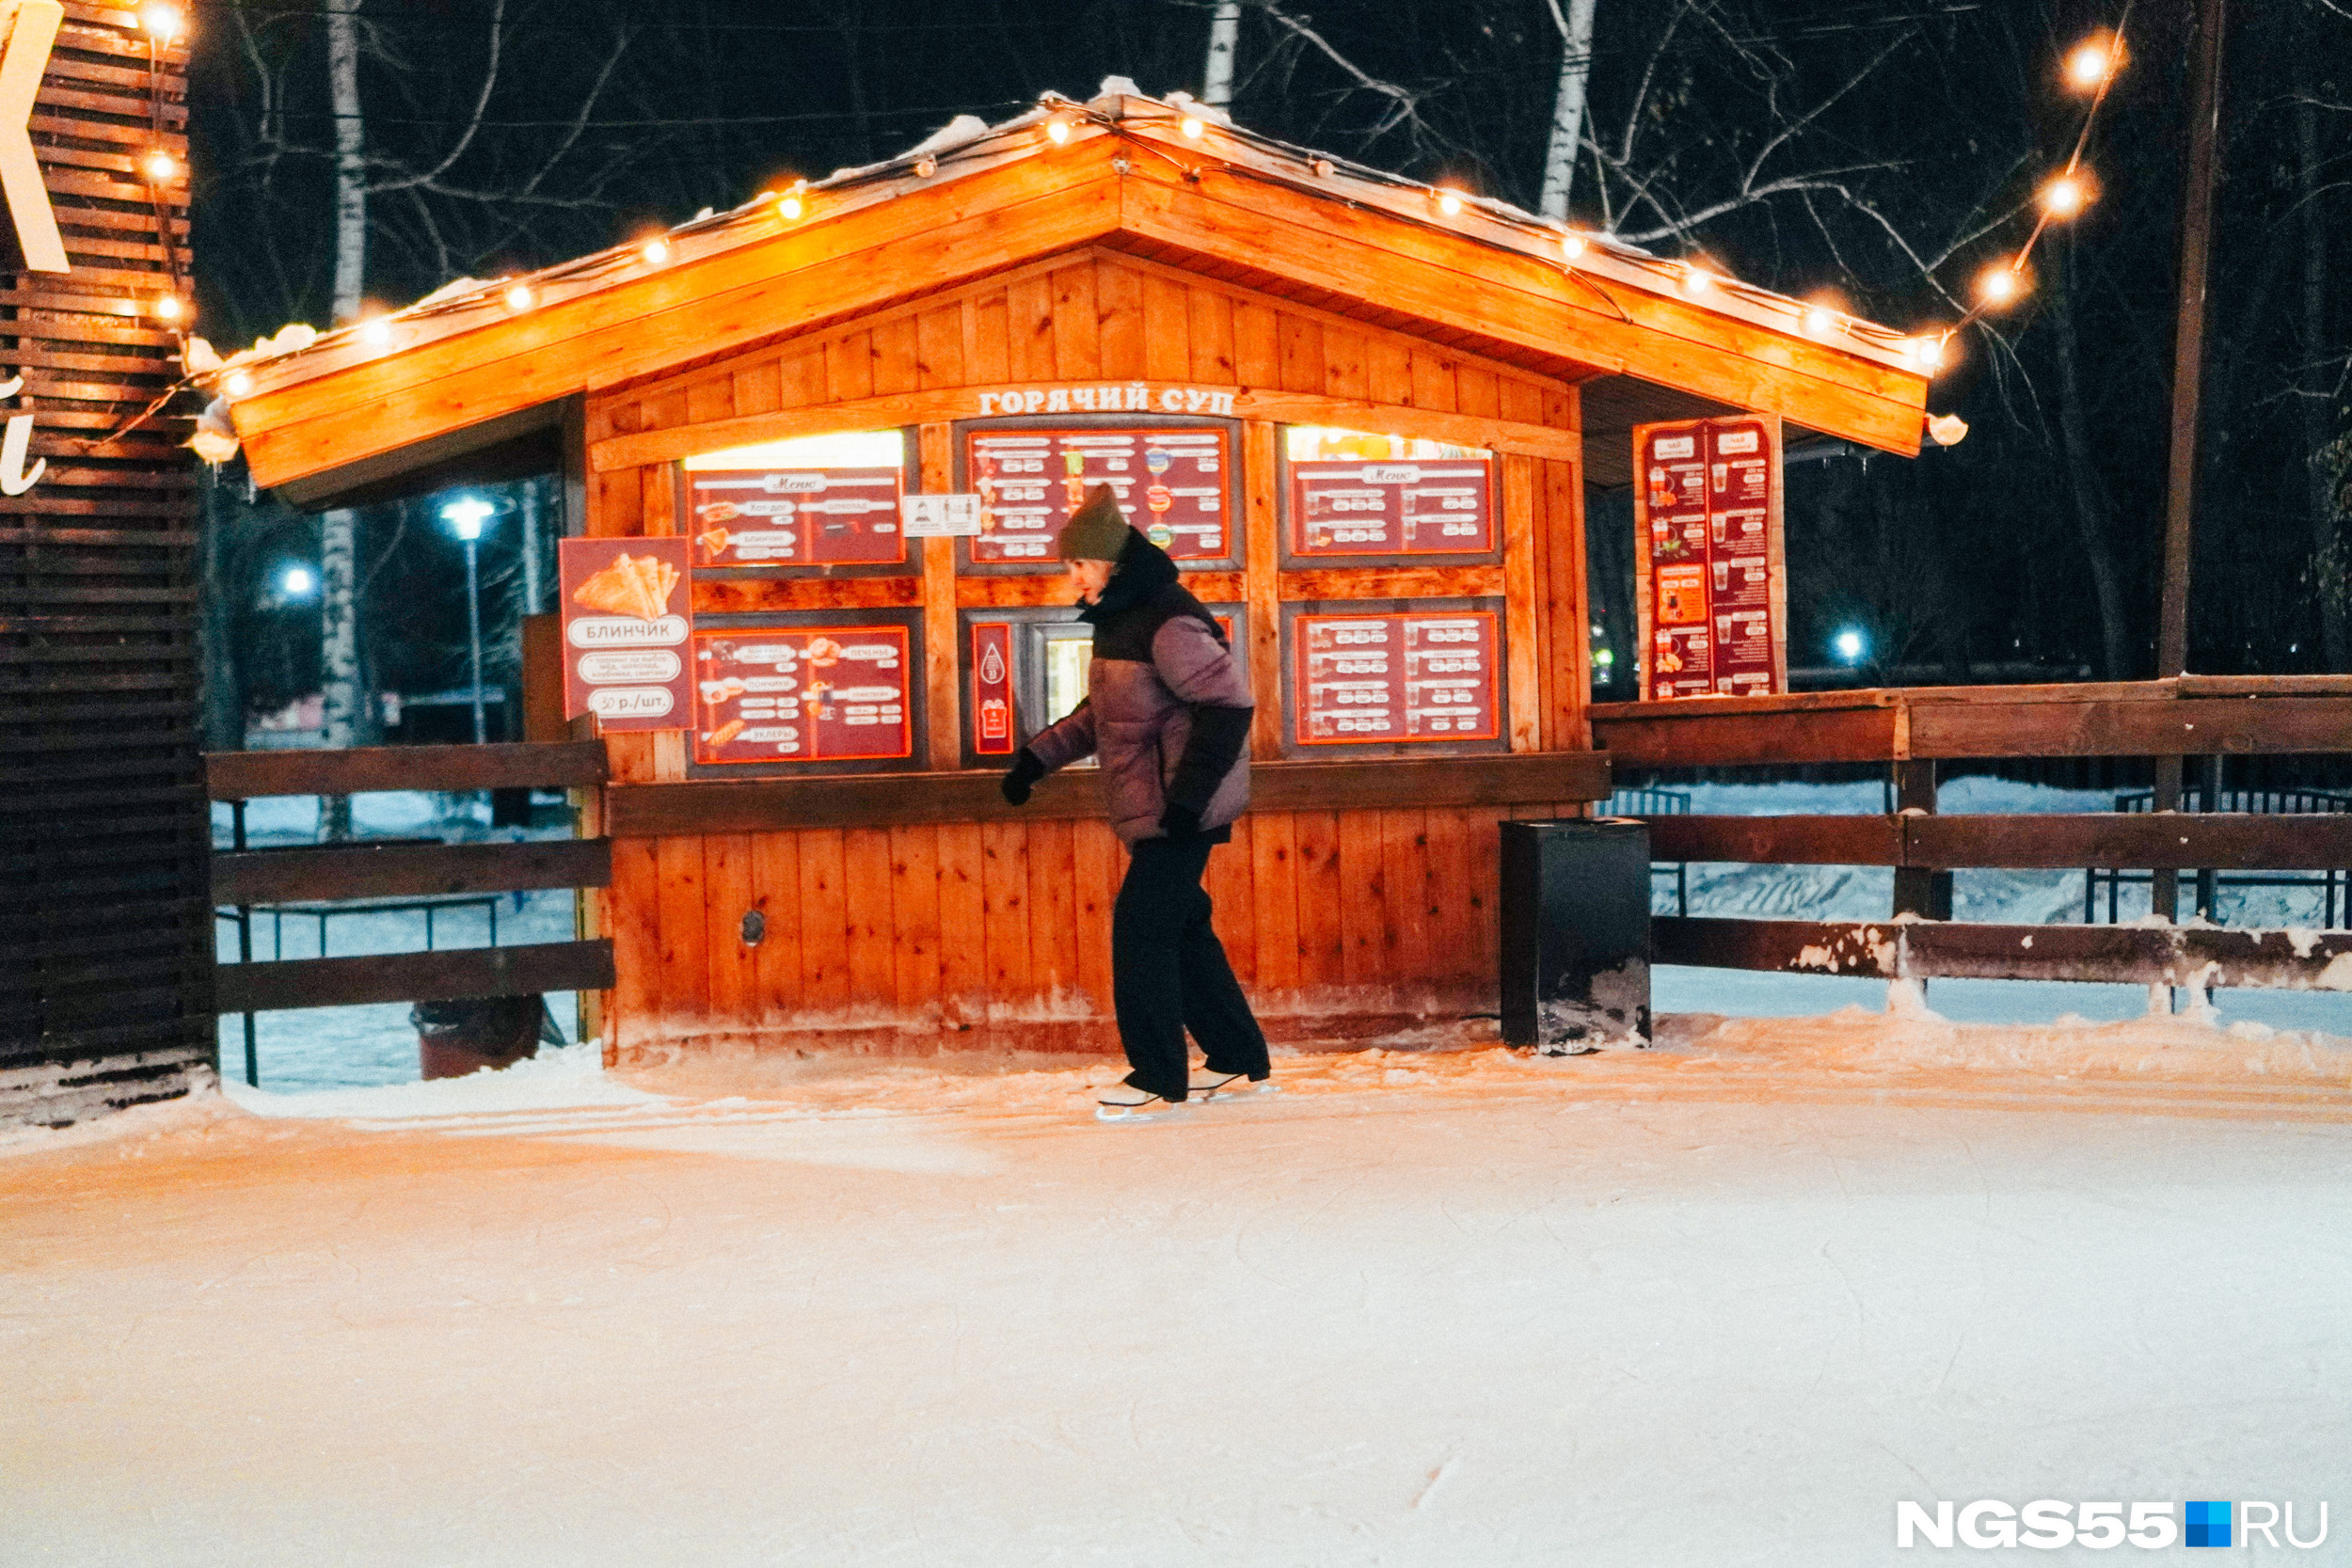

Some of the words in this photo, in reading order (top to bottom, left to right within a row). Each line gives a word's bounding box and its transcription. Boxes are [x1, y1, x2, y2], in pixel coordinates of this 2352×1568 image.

[978, 382, 1150, 416] ГОРЯЧИЙ
[1161, 388, 1235, 416] СУП
[1371, 468, 1411, 481] Меню
[773, 477, 817, 489] Меню
[586, 624, 670, 639] БЛИНЧИК
[619, 693, 666, 711] р./шт.
[754, 730, 793, 739] ЭКЛЕРЫ
